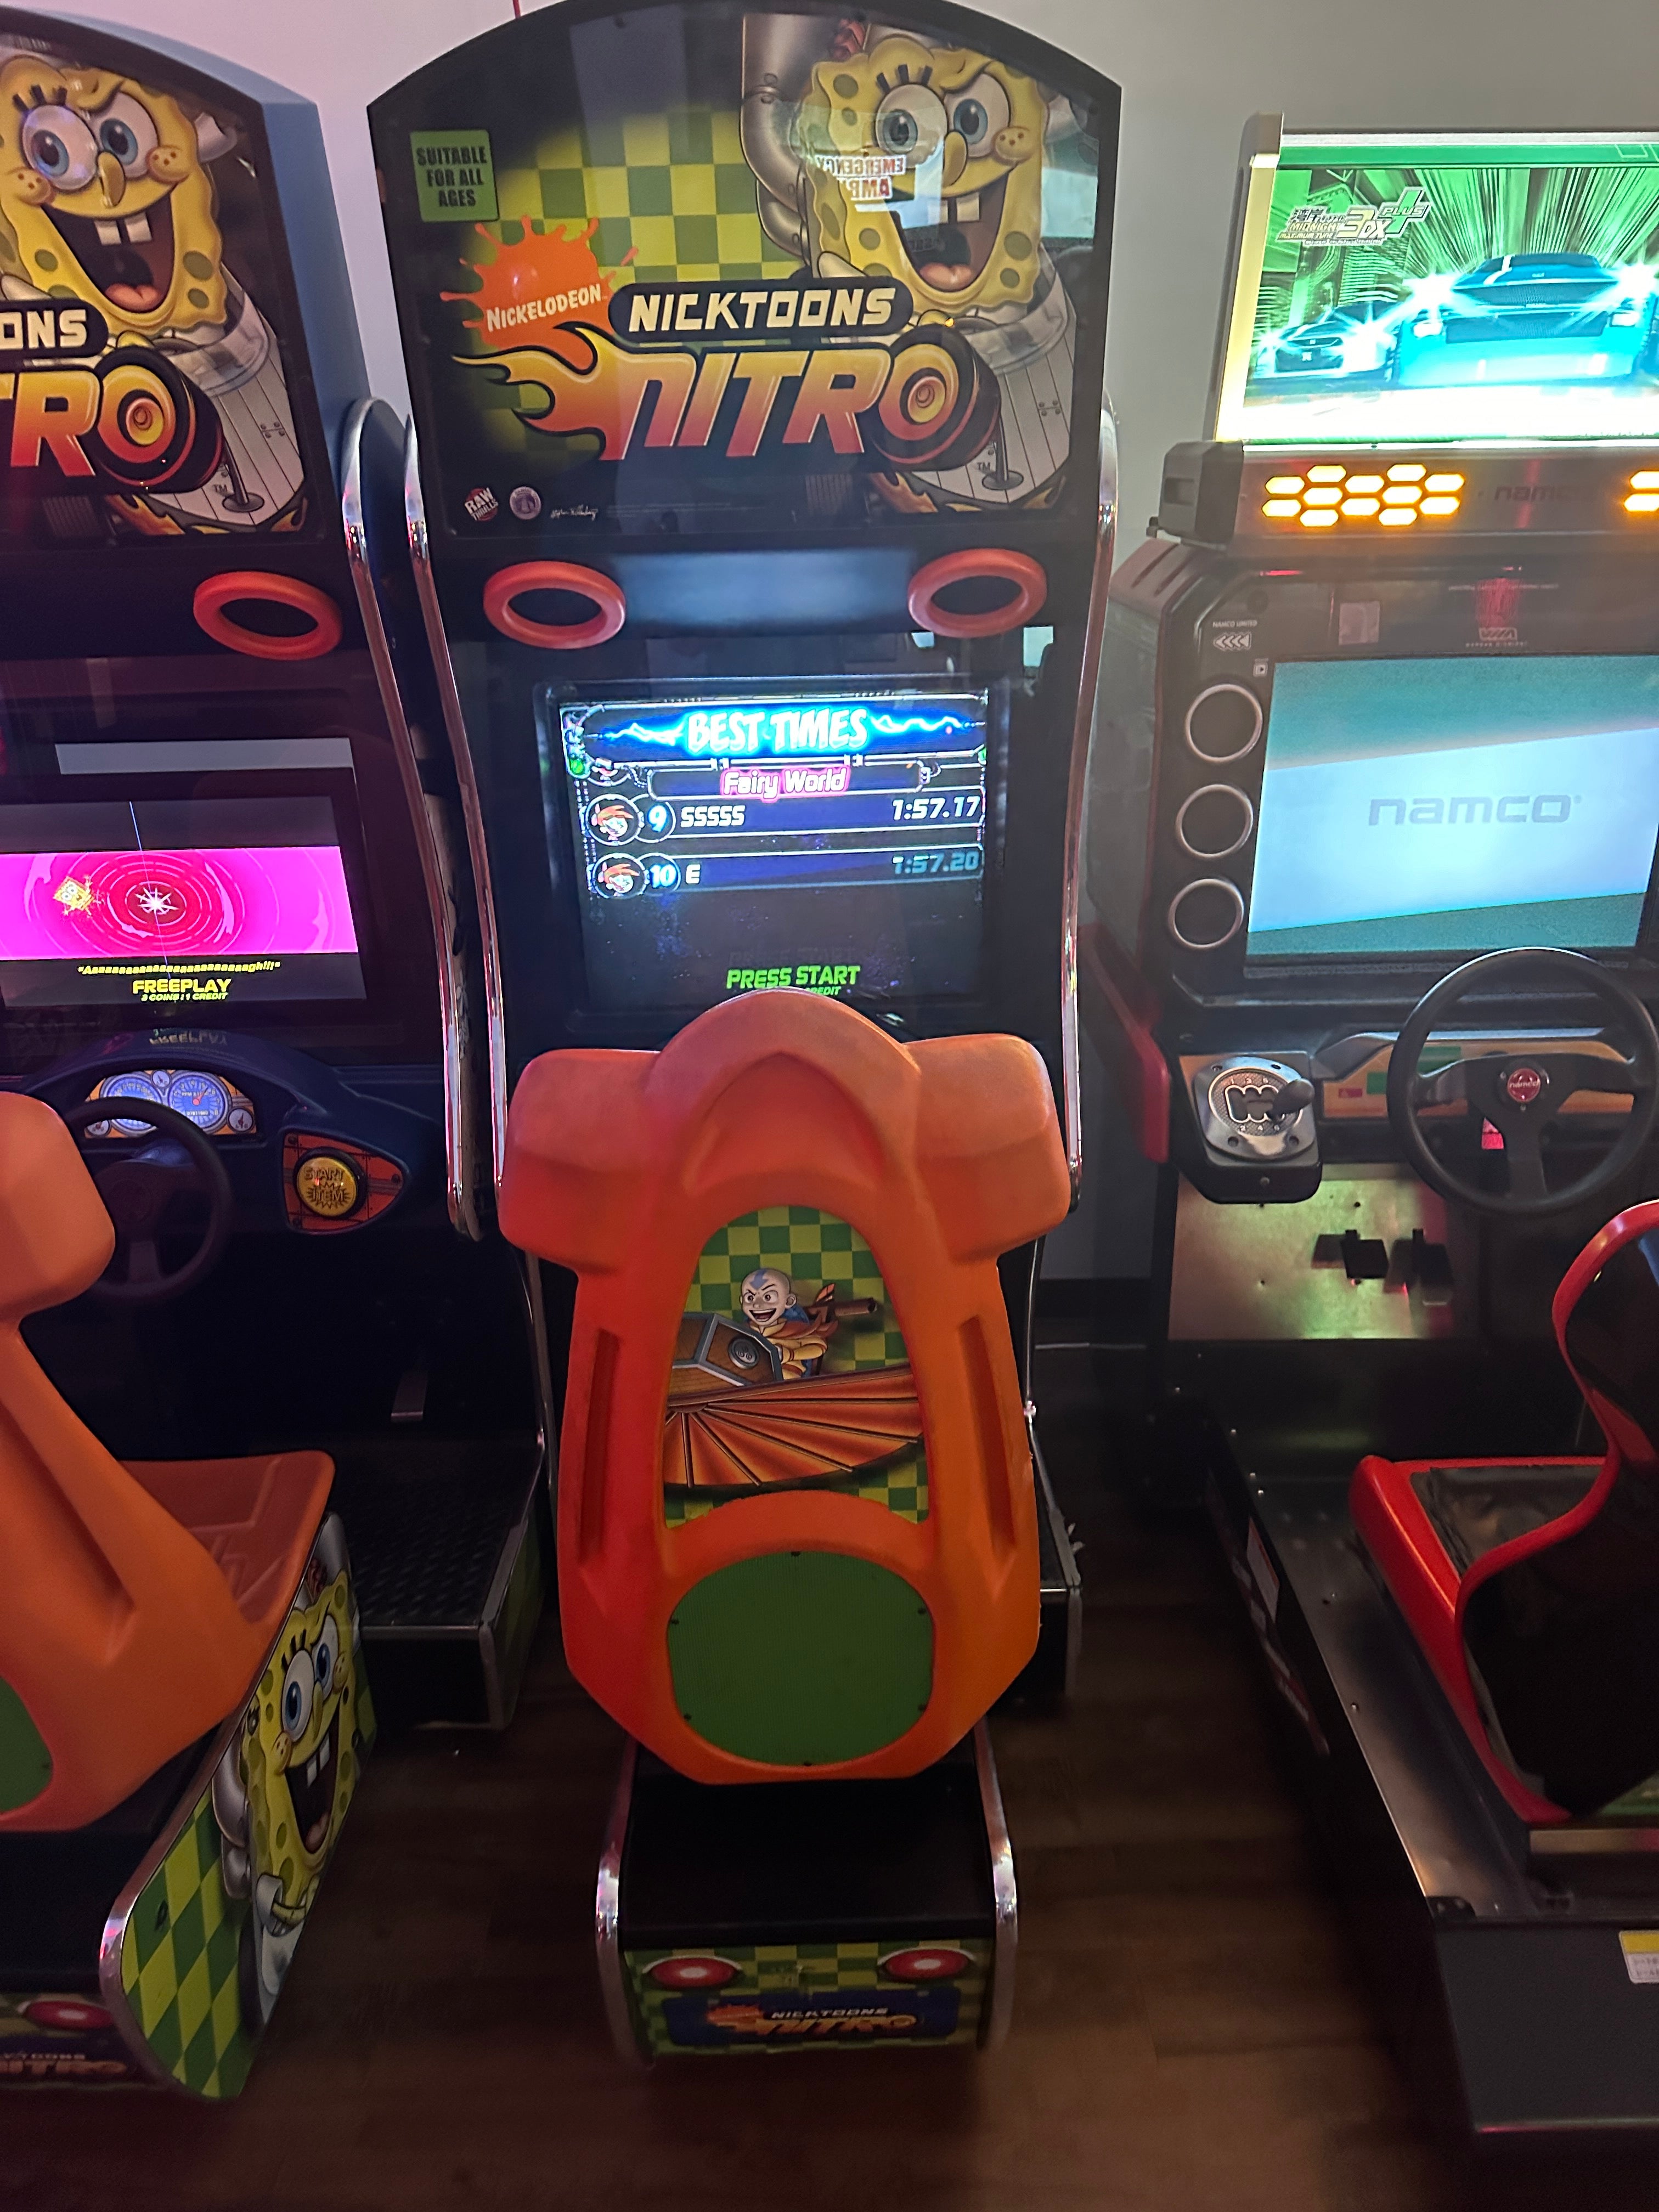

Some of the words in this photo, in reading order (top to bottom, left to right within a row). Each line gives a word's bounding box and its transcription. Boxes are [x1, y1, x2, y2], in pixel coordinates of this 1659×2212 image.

[416, 146, 487, 165] SUITABLE
[427, 169, 454, 187] FOR
[459, 168, 484, 185] ALL
[438, 189, 476, 207] AGES
[1382, 206, 1425, 216] PLUS
[487, 284, 601, 332] NICKELODEON
[628, 288, 896, 332] NICKTOONS
[600, 343, 959, 460] NITRO
[465, 487, 494, 514] RAW
[688, 711, 765, 752] BEST
[770, 708, 867, 752] TIMES
[724, 769, 780, 799] Fairy
[785, 767, 848, 793] World
[648, 804, 667, 832] 9
[680, 805, 746, 827] SSSSS
[893, 795, 980, 820] 1:57.17
[1369, 794, 1571, 826] namco
[650, 864, 677, 888] 10
[685, 864, 701, 884] E
[892, 851, 980, 874] 1:57.20
[133, 979, 231, 994] FREEPLAY
[726, 967, 792, 989] PRESS
[796, 966, 860, 985] START
[304, 1166, 346, 1181] START
[313, 1187, 345, 1201] ITEM
